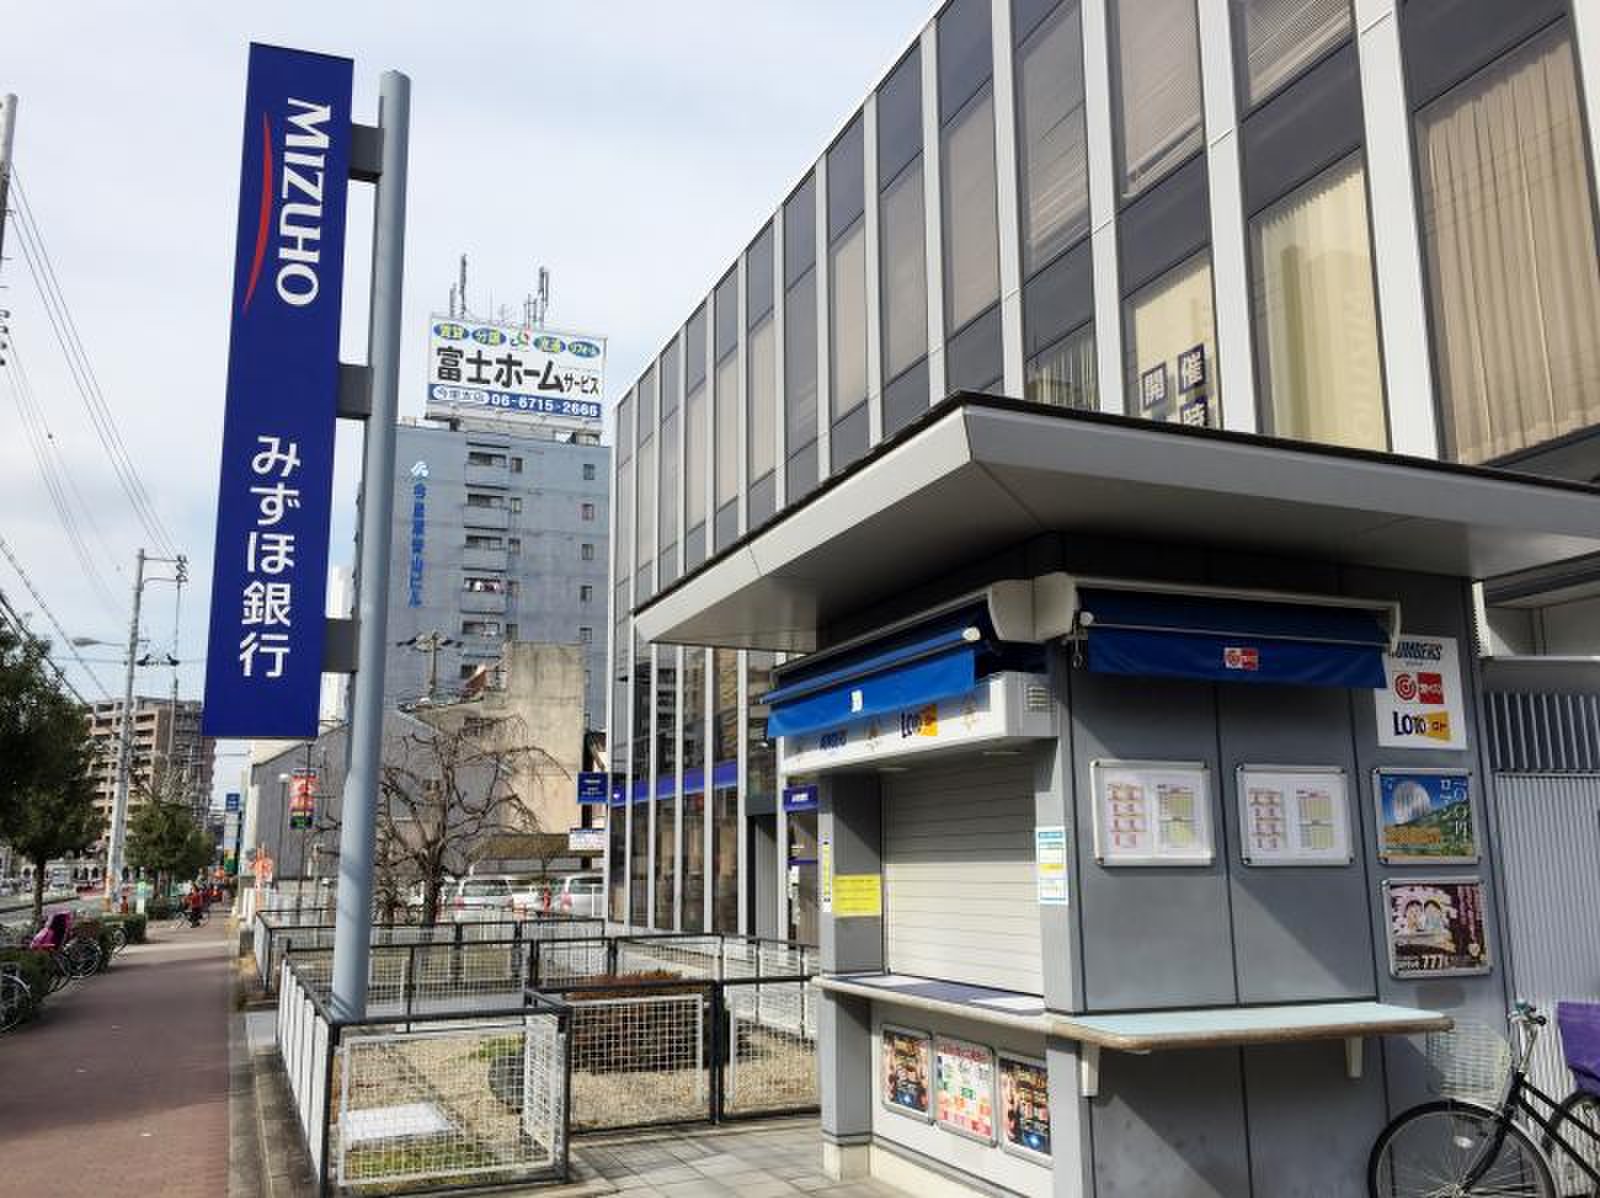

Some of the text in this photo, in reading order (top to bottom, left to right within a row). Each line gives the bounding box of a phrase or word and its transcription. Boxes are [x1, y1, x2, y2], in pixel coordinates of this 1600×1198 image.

[276, 97, 332, 307] MIZUHO
[239, 435, 301, 678] みずほ銀行
